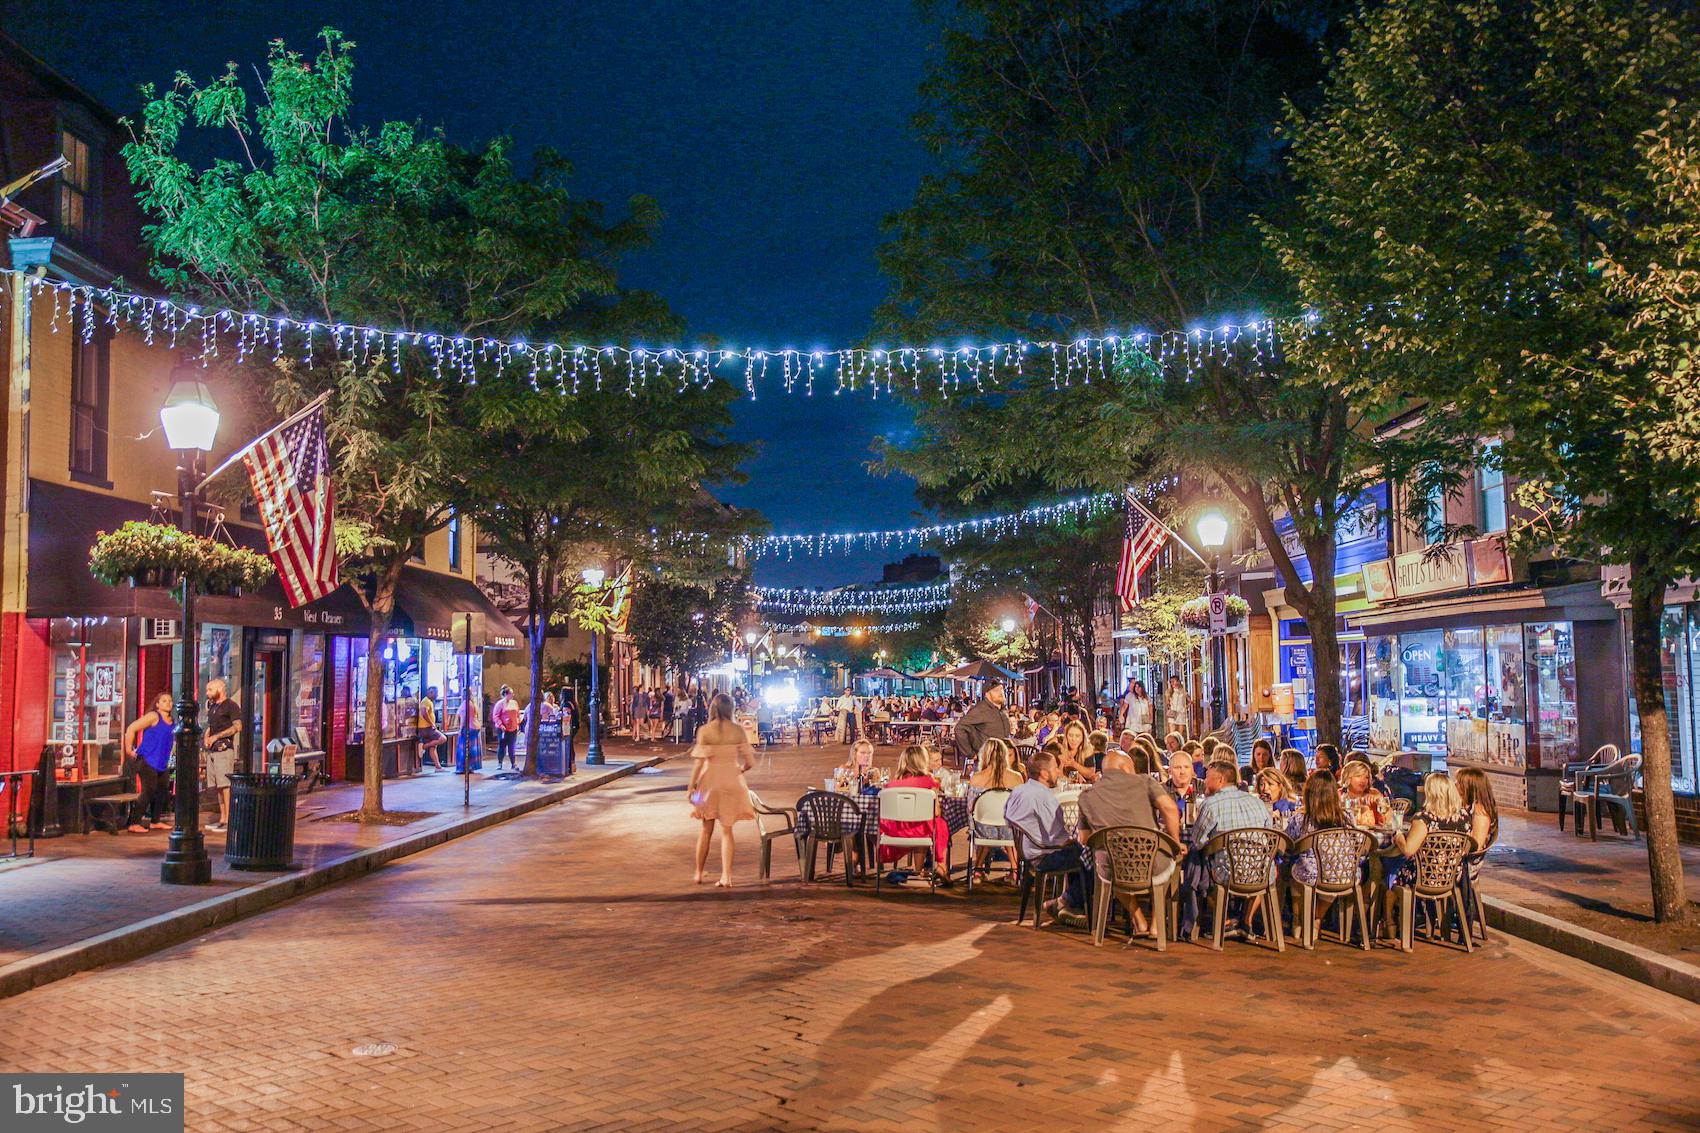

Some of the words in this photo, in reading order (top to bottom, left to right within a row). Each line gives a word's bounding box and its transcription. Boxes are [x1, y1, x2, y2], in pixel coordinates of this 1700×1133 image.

[273, 606, 283, 620] 35
[303, 609, 317, 623] West
[428, 628, 451, 638] SALOO
[1403, 650, 1431, 661] OPEN
[63, 668, 76, 756] ESPRESSO
[1411, 734, 1438, 742] HEAVY
